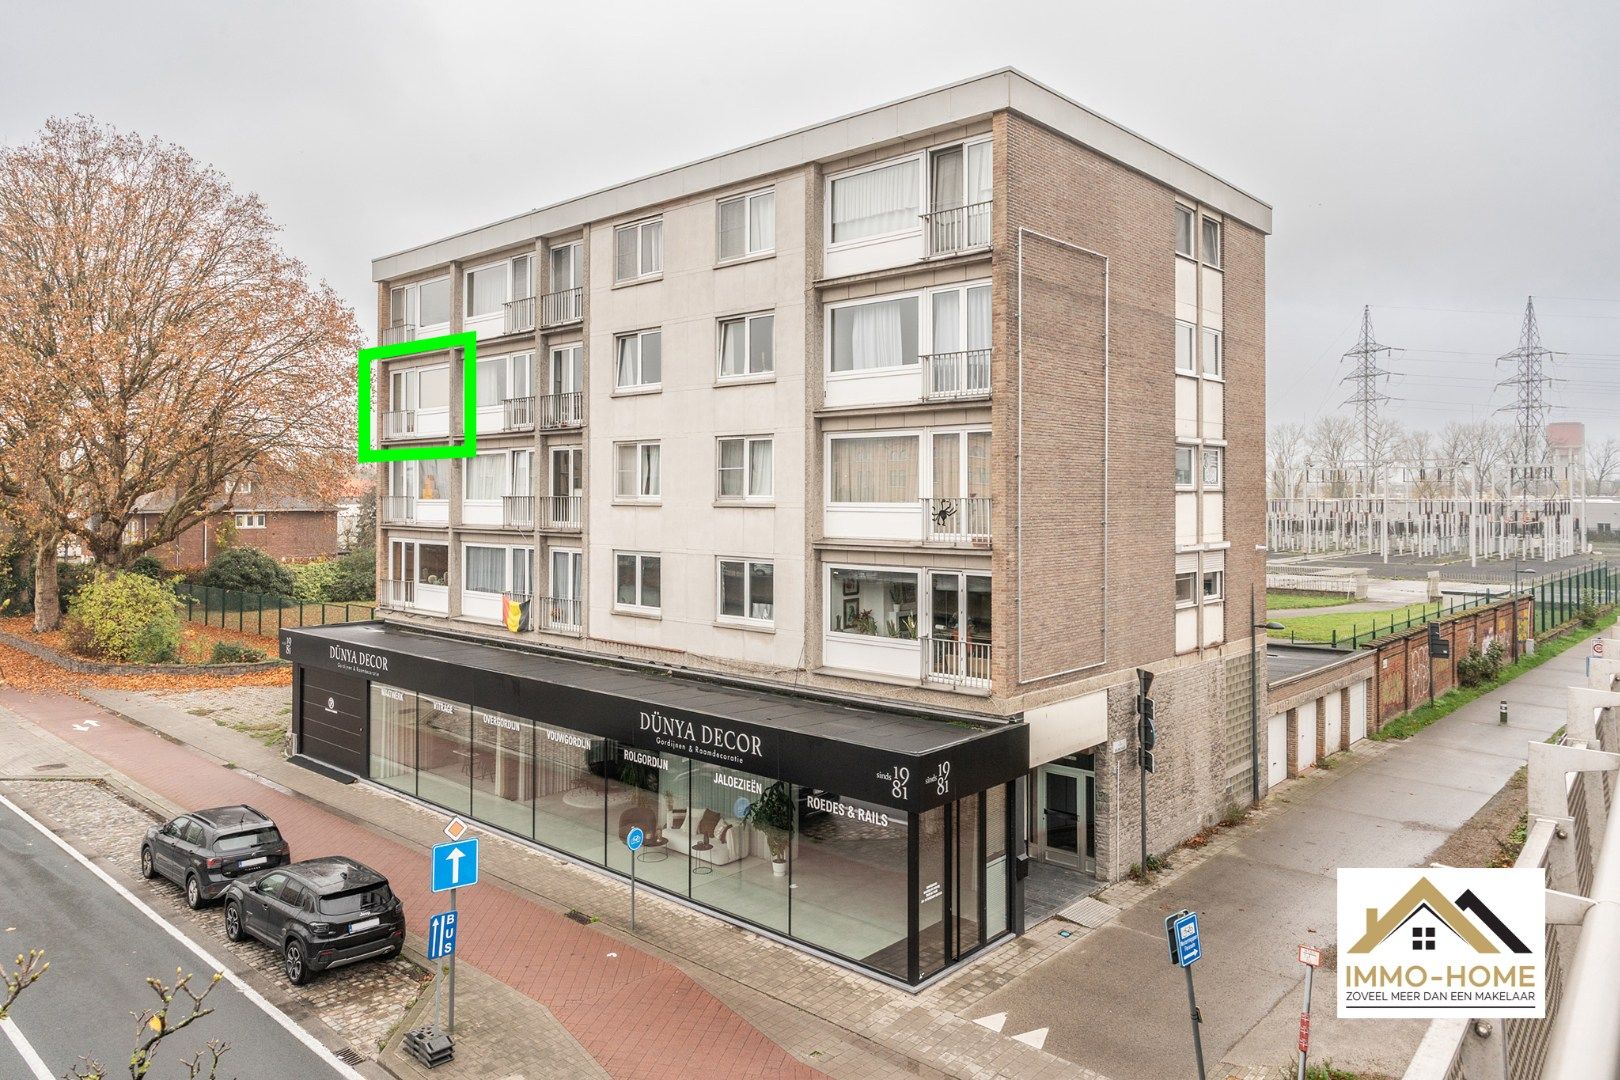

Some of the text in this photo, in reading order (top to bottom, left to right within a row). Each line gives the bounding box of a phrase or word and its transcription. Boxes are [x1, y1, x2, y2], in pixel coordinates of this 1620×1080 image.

[329, 645, 388, 671] DÜNYA DECOR
[483, 714, 520, 732] OVERGORDIJN
[546, 730, 591, 750] VOUWGORDIJN
[640, 711, 762, 757] DÜNYA DECOR
[623, 749, 669, 771] ROLGORDIJN
[656, 737, 686, 750] Gordijnen
[695, 746, 744, 764] Raamdecoratie
[876, 771, 892, 781] sinds
[893, 766, 910, 786] 19
[938, 761, 950, 780] 19
[713, 772, 762, 794] JALOEZIEËN
[892, 780, 908, 800] 81
[937, 777, 949, 795] 81
[807, 795, 888, 827] ROEDES & RAILS
[444, 914, 455, 953] BUS
